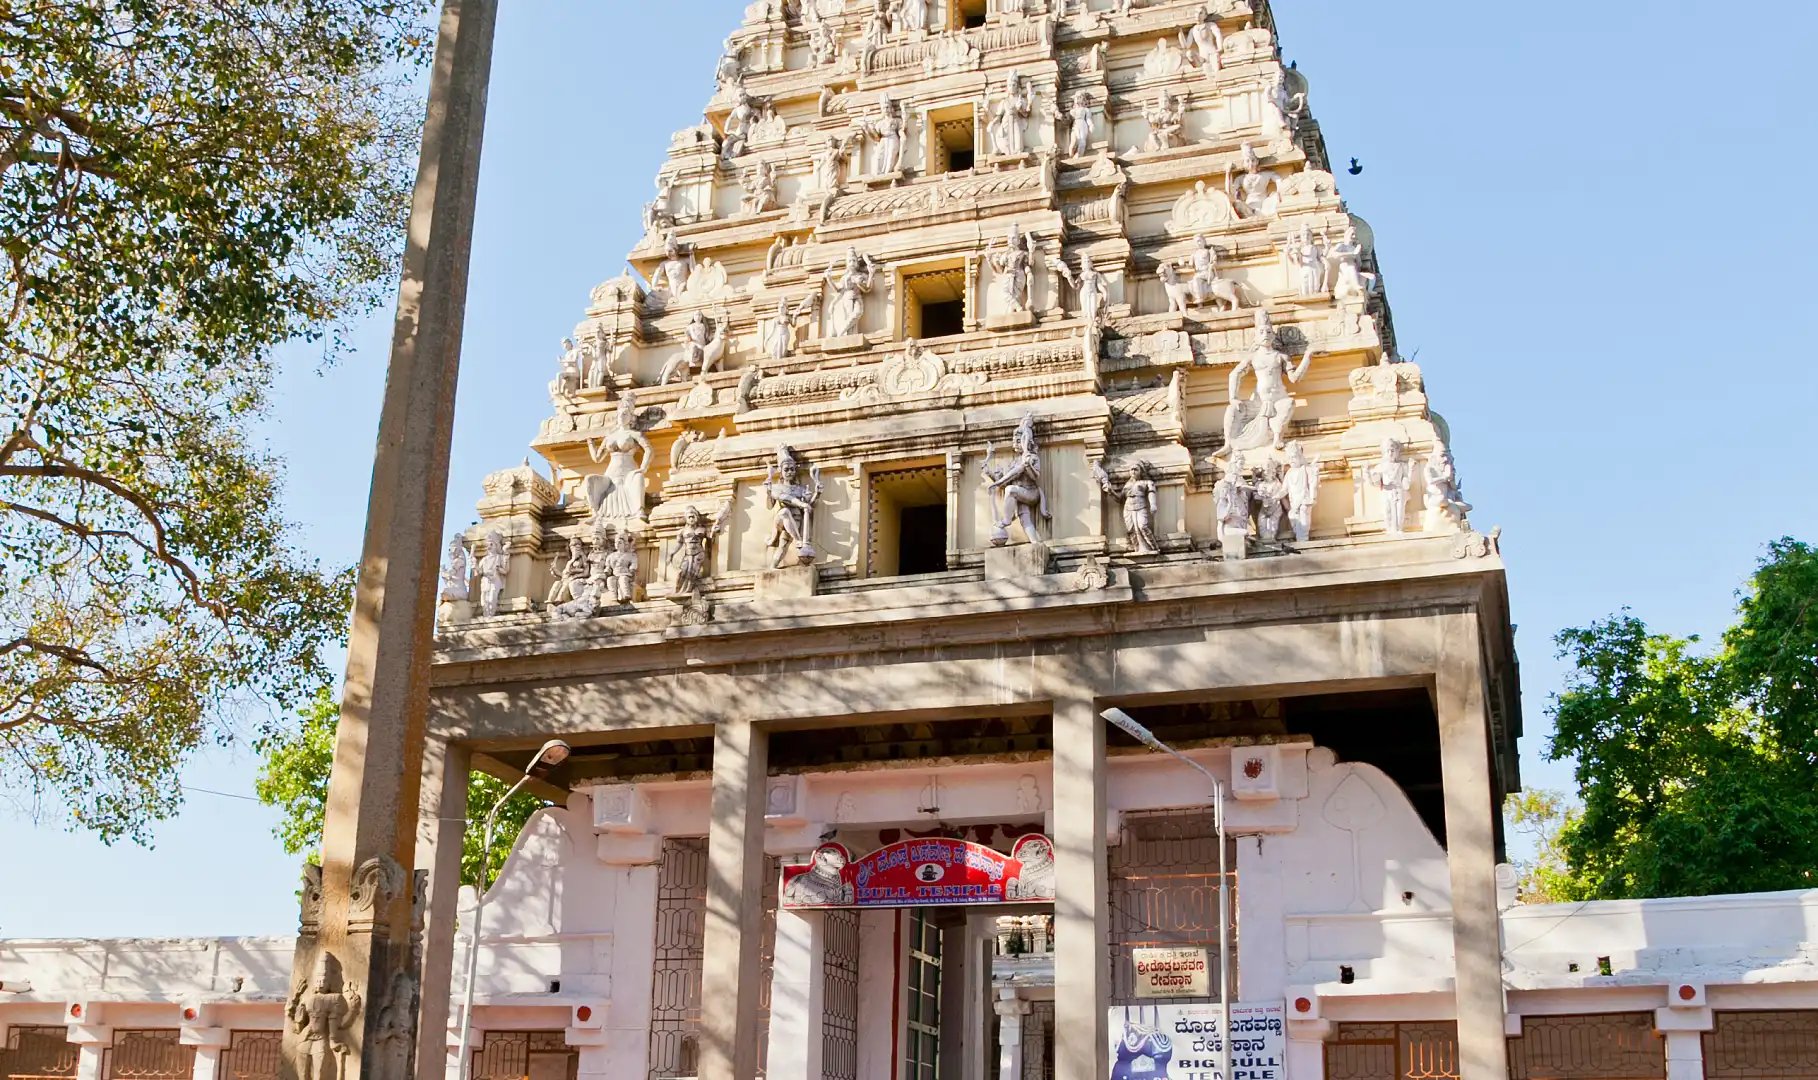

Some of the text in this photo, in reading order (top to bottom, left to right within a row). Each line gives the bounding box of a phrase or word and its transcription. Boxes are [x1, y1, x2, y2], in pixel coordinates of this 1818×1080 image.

[857, 884, 1002, 899] BULL TEMPLE
[1175, 1016, 1282, 1038] ದೊಡ್ಡ ಬಸವಣ್ಣ
[1179, 1059, 1215, 1069] BIG
